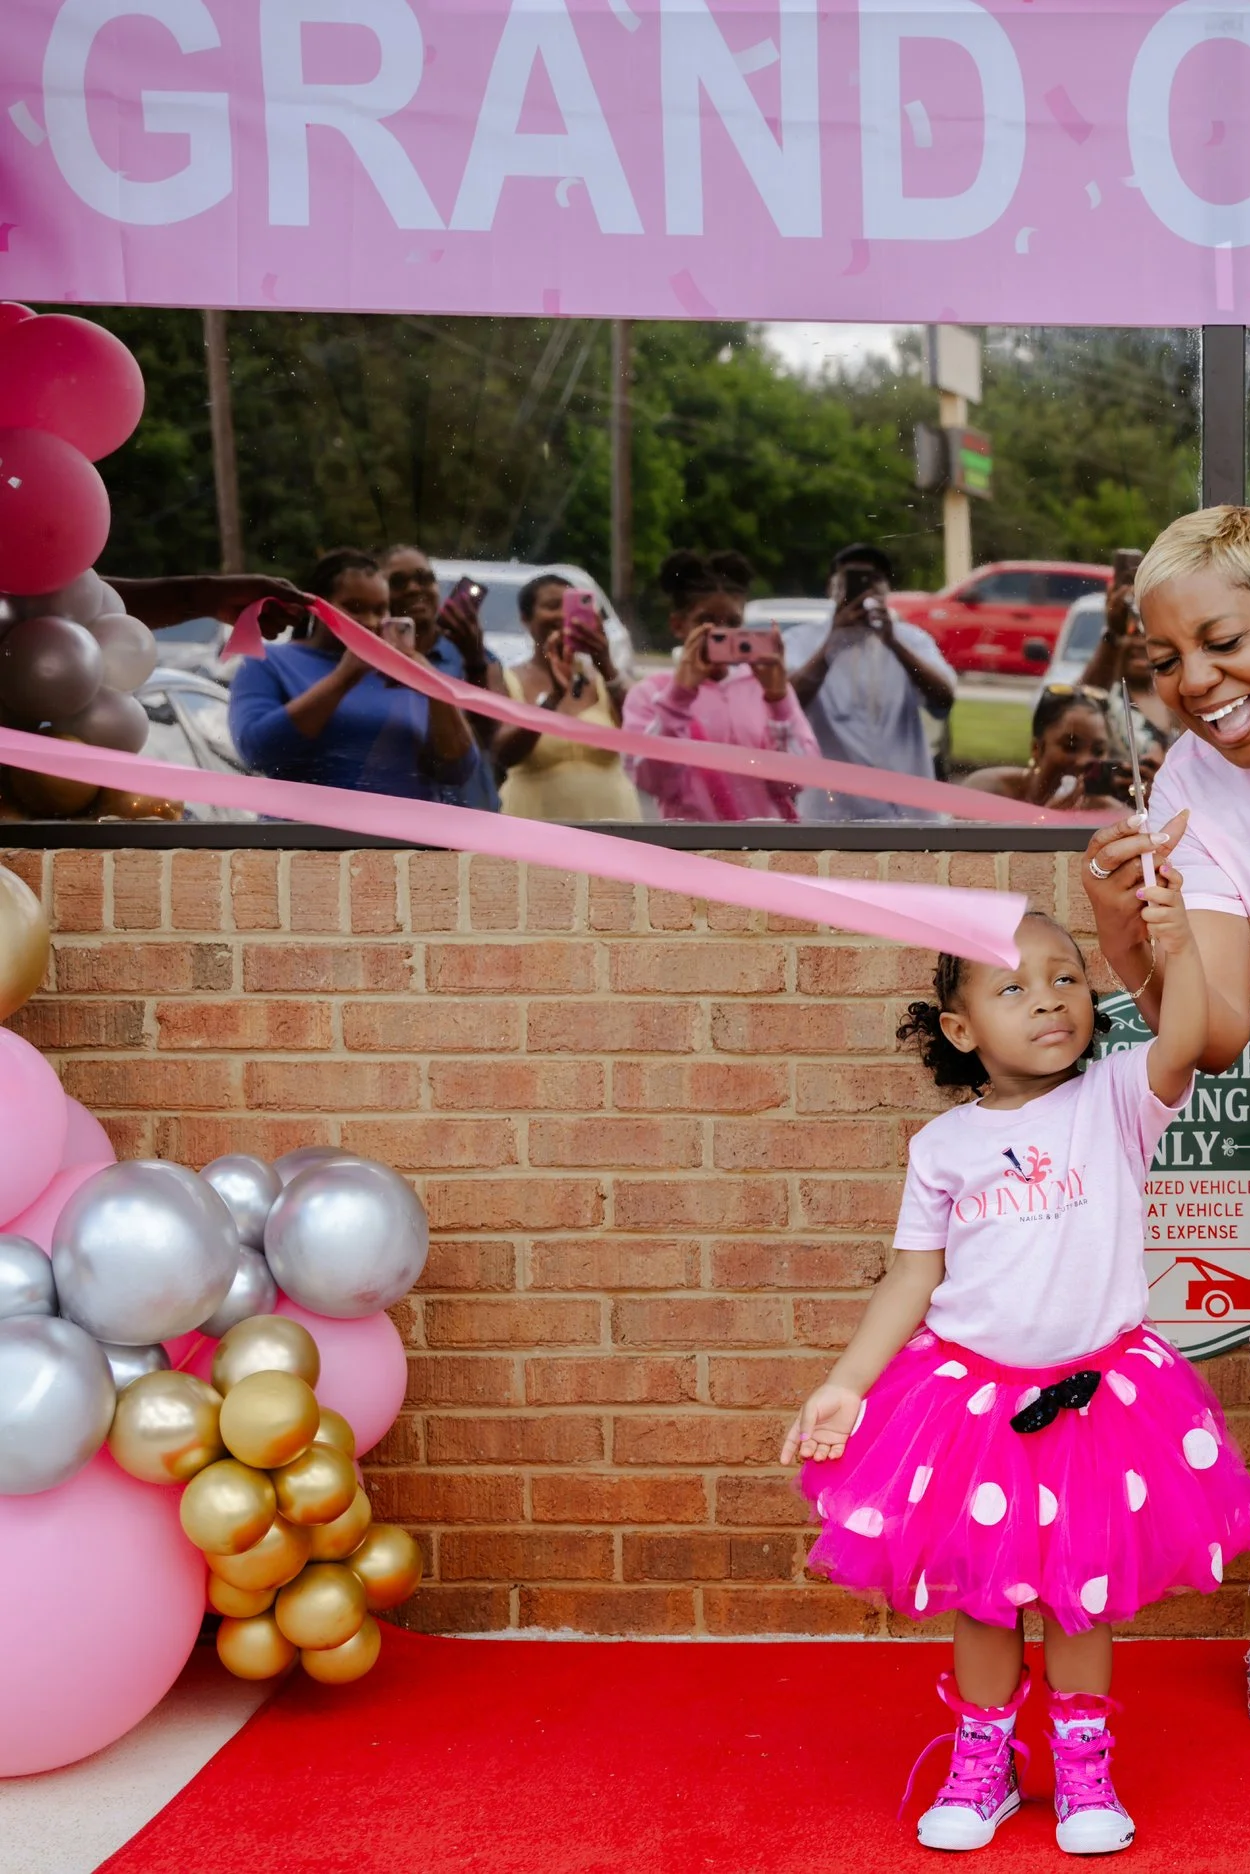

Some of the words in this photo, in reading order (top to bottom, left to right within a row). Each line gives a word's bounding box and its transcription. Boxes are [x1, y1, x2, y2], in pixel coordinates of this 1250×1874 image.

[42, 0, 1026, 240] GRAND
[1173, 1088, 1250, 1122] ING
[1154, 1131, 1220, 1166] NLY
[1019, 1213, 1043, 1223] NAILS
[1147, 1203, 1168, 1217] AT
[1176, 1202, 1244, 1217] VEHICLE
[1167, 1225, 1238, 1239] EXPENSE
